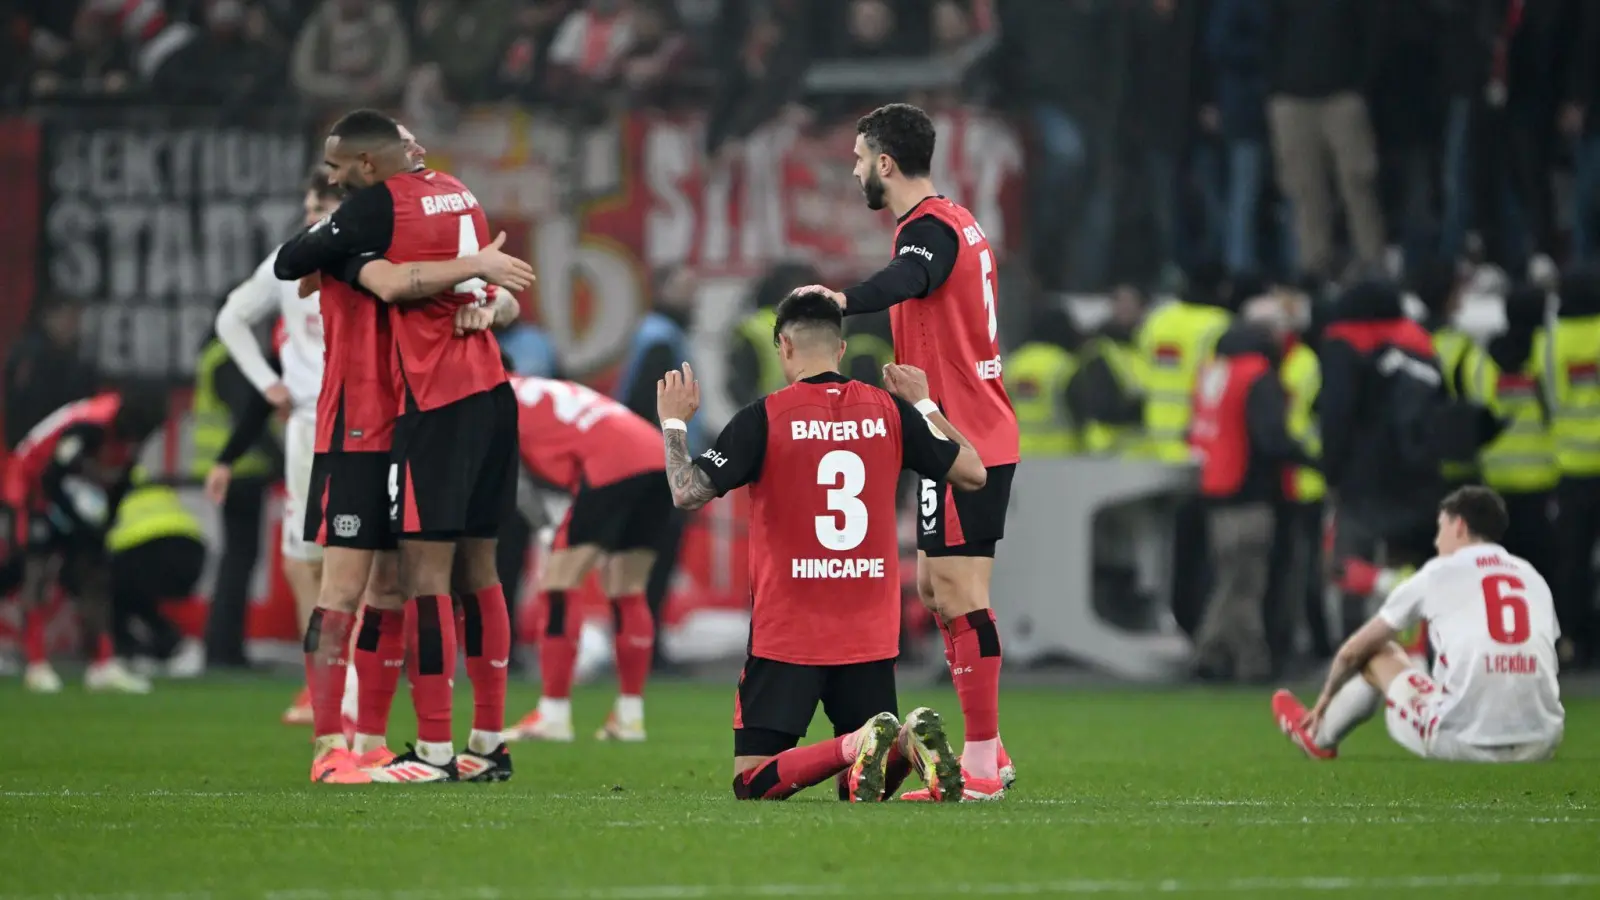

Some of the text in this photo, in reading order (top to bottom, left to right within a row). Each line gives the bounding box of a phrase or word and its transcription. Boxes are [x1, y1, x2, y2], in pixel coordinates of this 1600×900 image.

[421, 192, 466, 216] BAYER
[791, 417, 887, 441] BAYER 04
[814, 449, 869, 551] 3
[921, 478, 938, 517] 5
[791, 557, 885, 579] HINCAPIE
[1481, 572, 1531, 645] 6
[1495, 653, 1508, 674] FC
